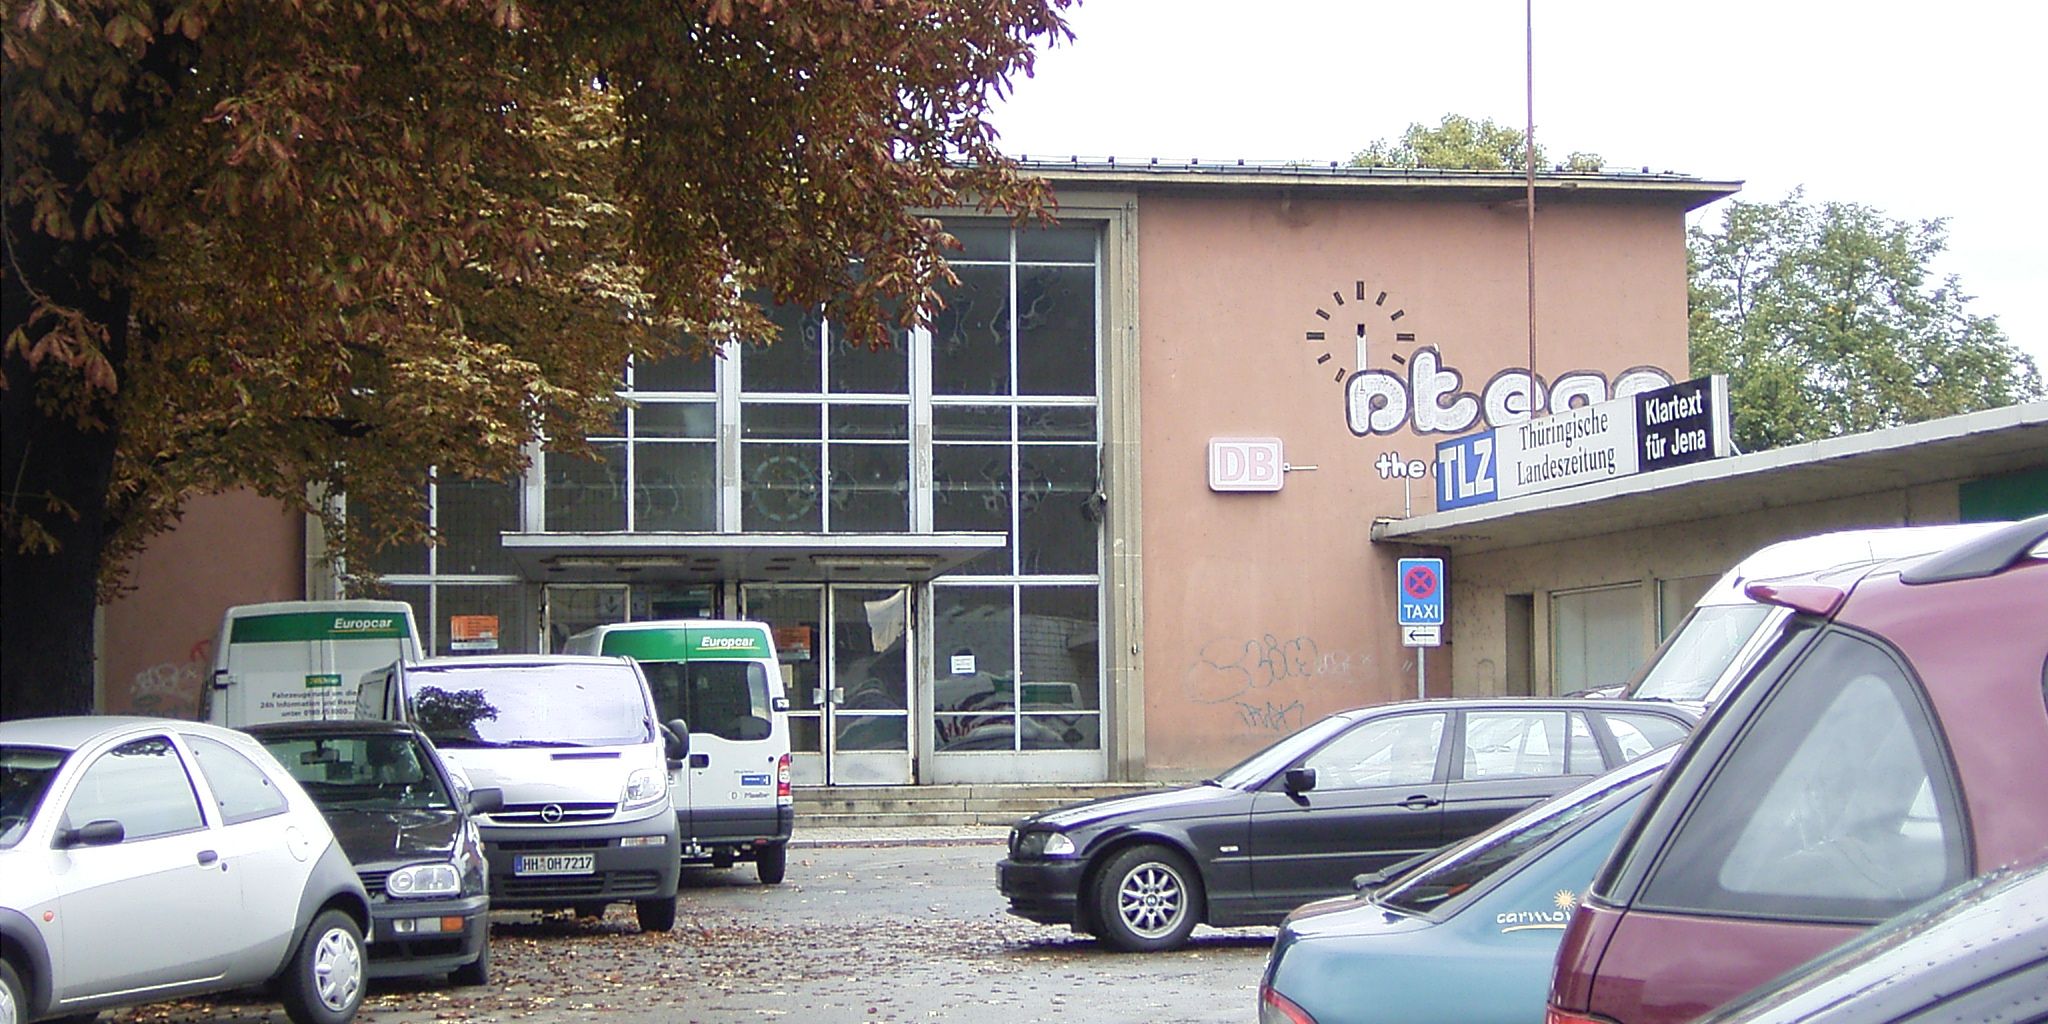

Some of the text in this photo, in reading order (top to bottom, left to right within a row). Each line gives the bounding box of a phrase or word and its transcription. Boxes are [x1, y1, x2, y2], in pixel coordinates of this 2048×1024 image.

[1645, 389, 1702, 426] Klartext
[1519, 408, 1608, 450] Thüringische
[1645, 428, 1707, 460] für Jena
[1219, 446, 1274, 482] DB
[1375, 451, 1426, 479] the
[1439, 438, 1494, 501] TLZ
[1517, 447, 1616, 486] Landeszeitung
[334, 617, 393, 631] Europcar
[1404, 604, 1439, 619] TAXI
[702, 636, 755, 648] Europcar
[523, 856, 592, 871] HH OH 7217
